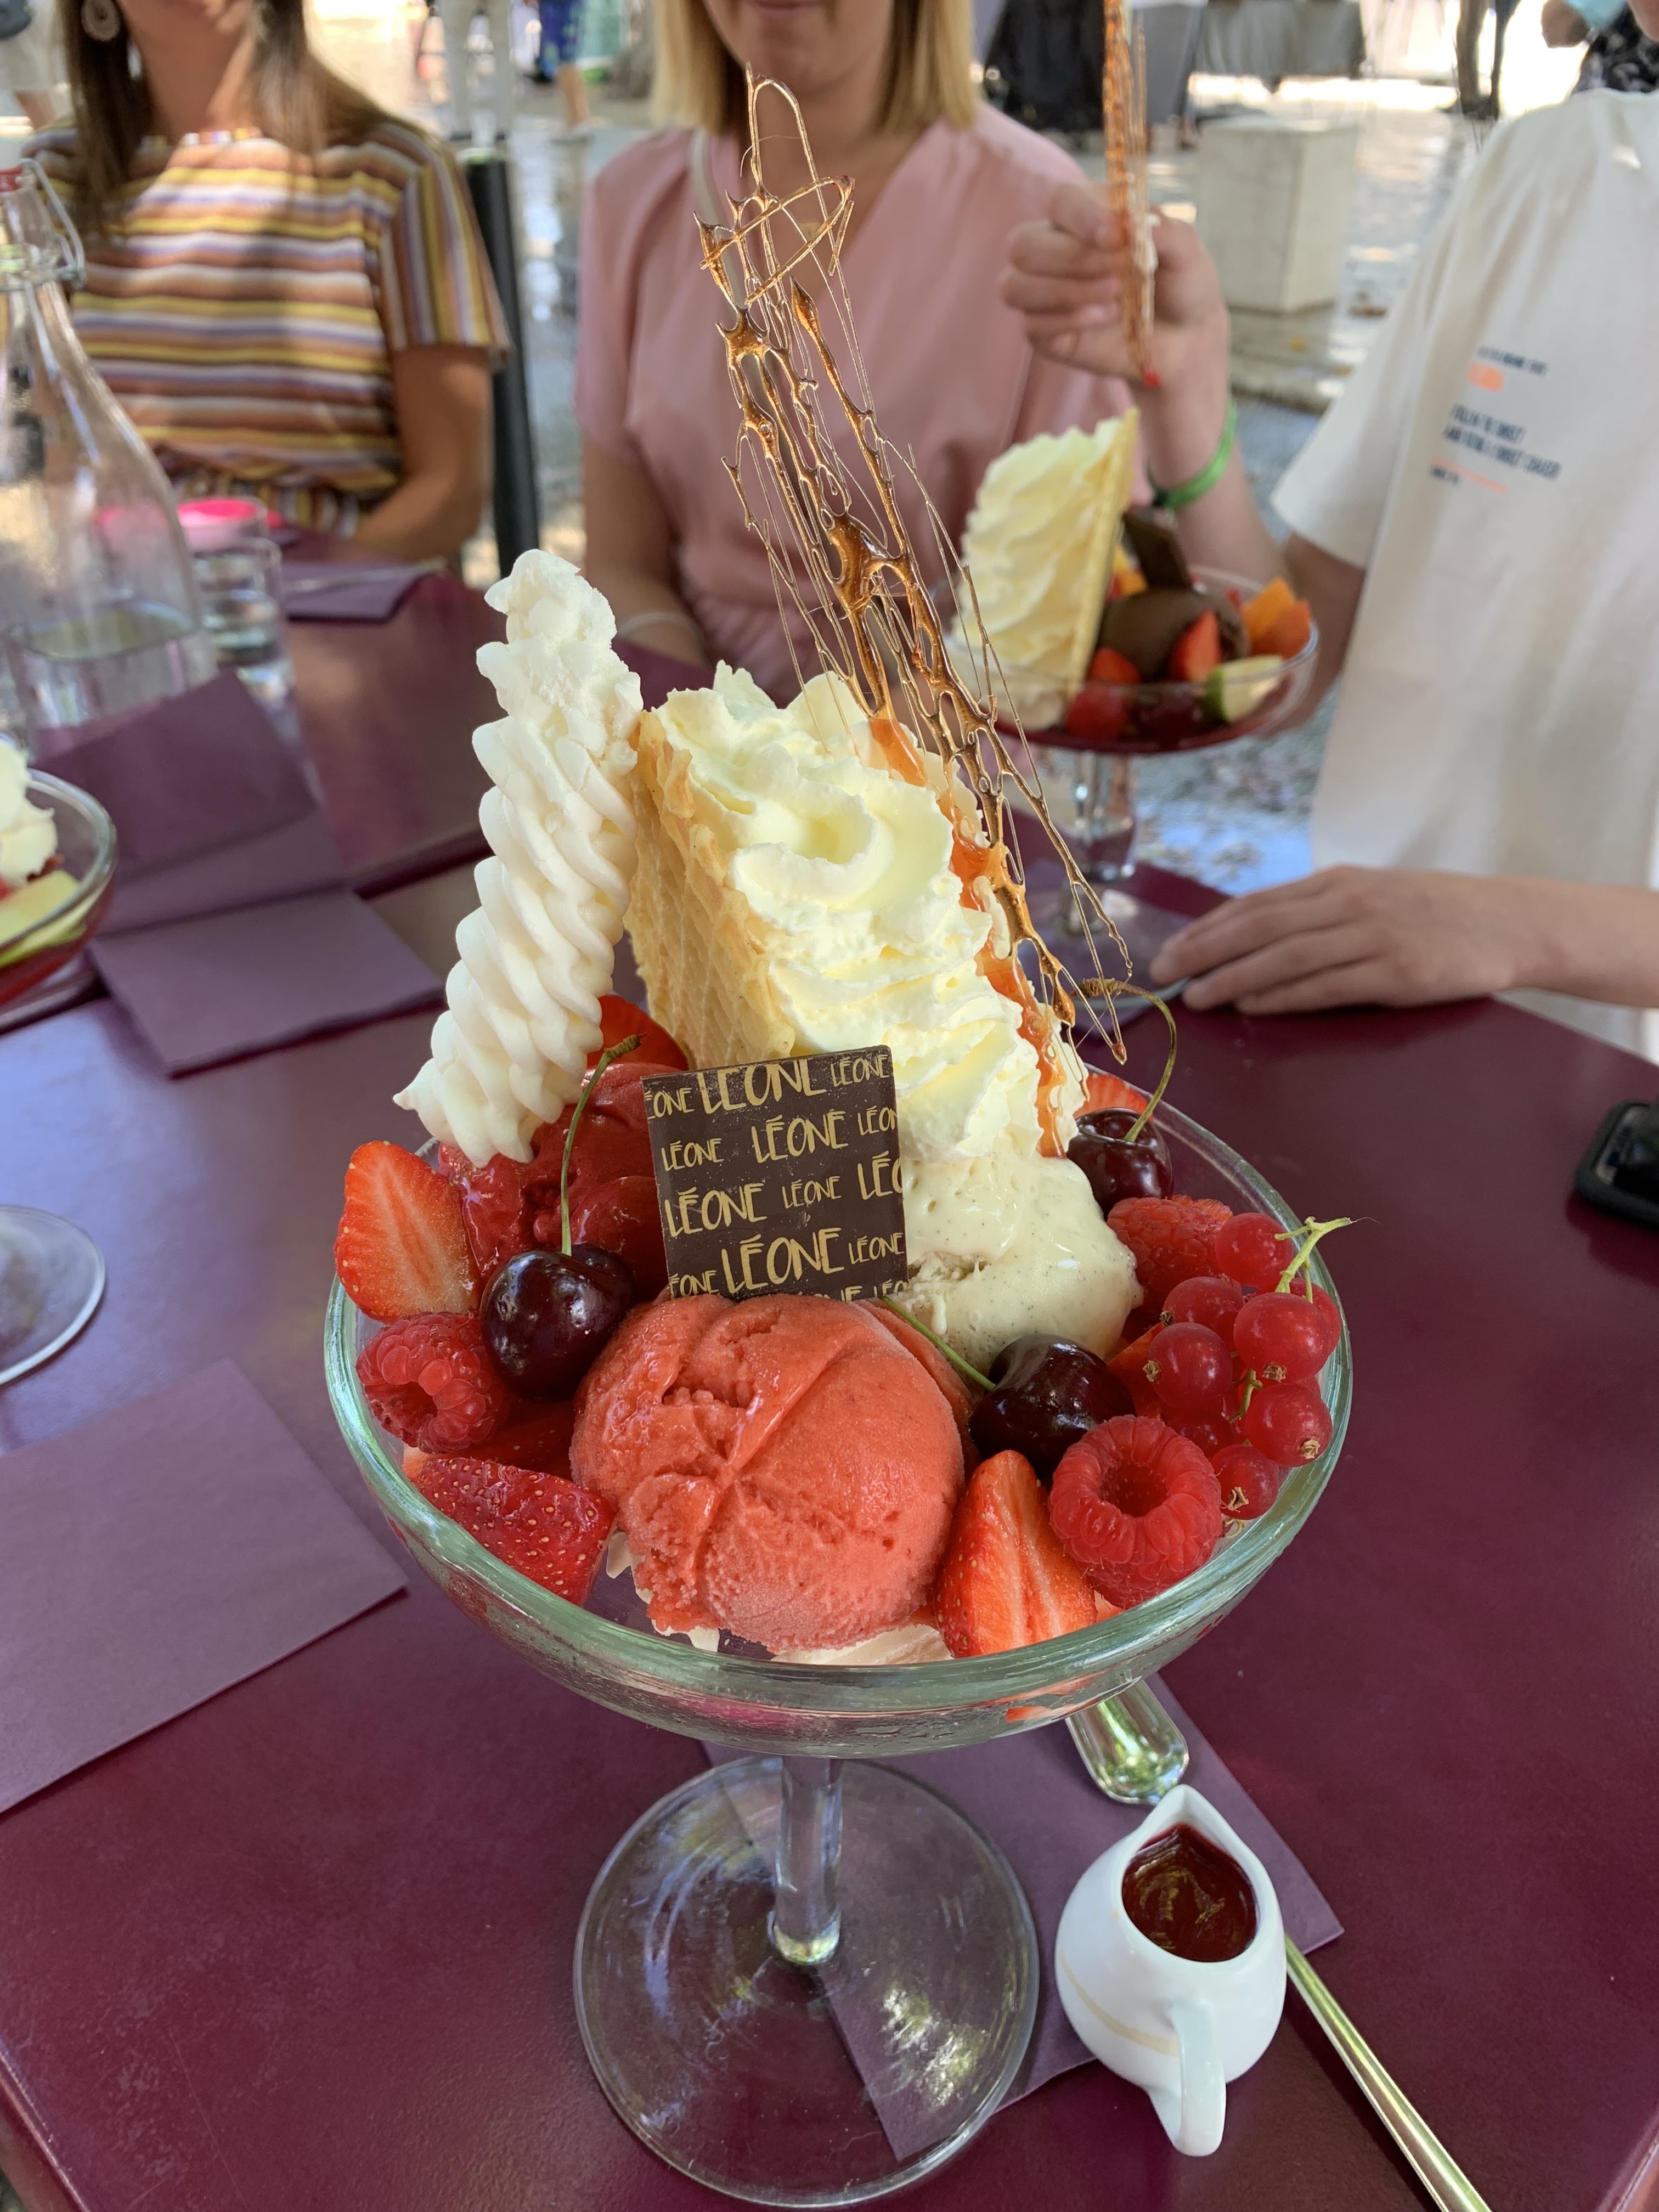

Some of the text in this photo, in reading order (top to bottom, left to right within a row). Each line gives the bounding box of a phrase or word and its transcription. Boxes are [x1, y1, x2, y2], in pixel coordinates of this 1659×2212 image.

[830, 1054, 890, 1087] LÉONE
[661, 1138, 725, 1172] LÉONE
[751, 1110, 849, 1164] LÉONE
[664, 1182, 768, 1238] LÉONE
[782, 1175, 842, 1209] LÉONE
[721, 1227, 845, 1294] LÉONE
[848, 1232, 905, 1265] LÉONE
